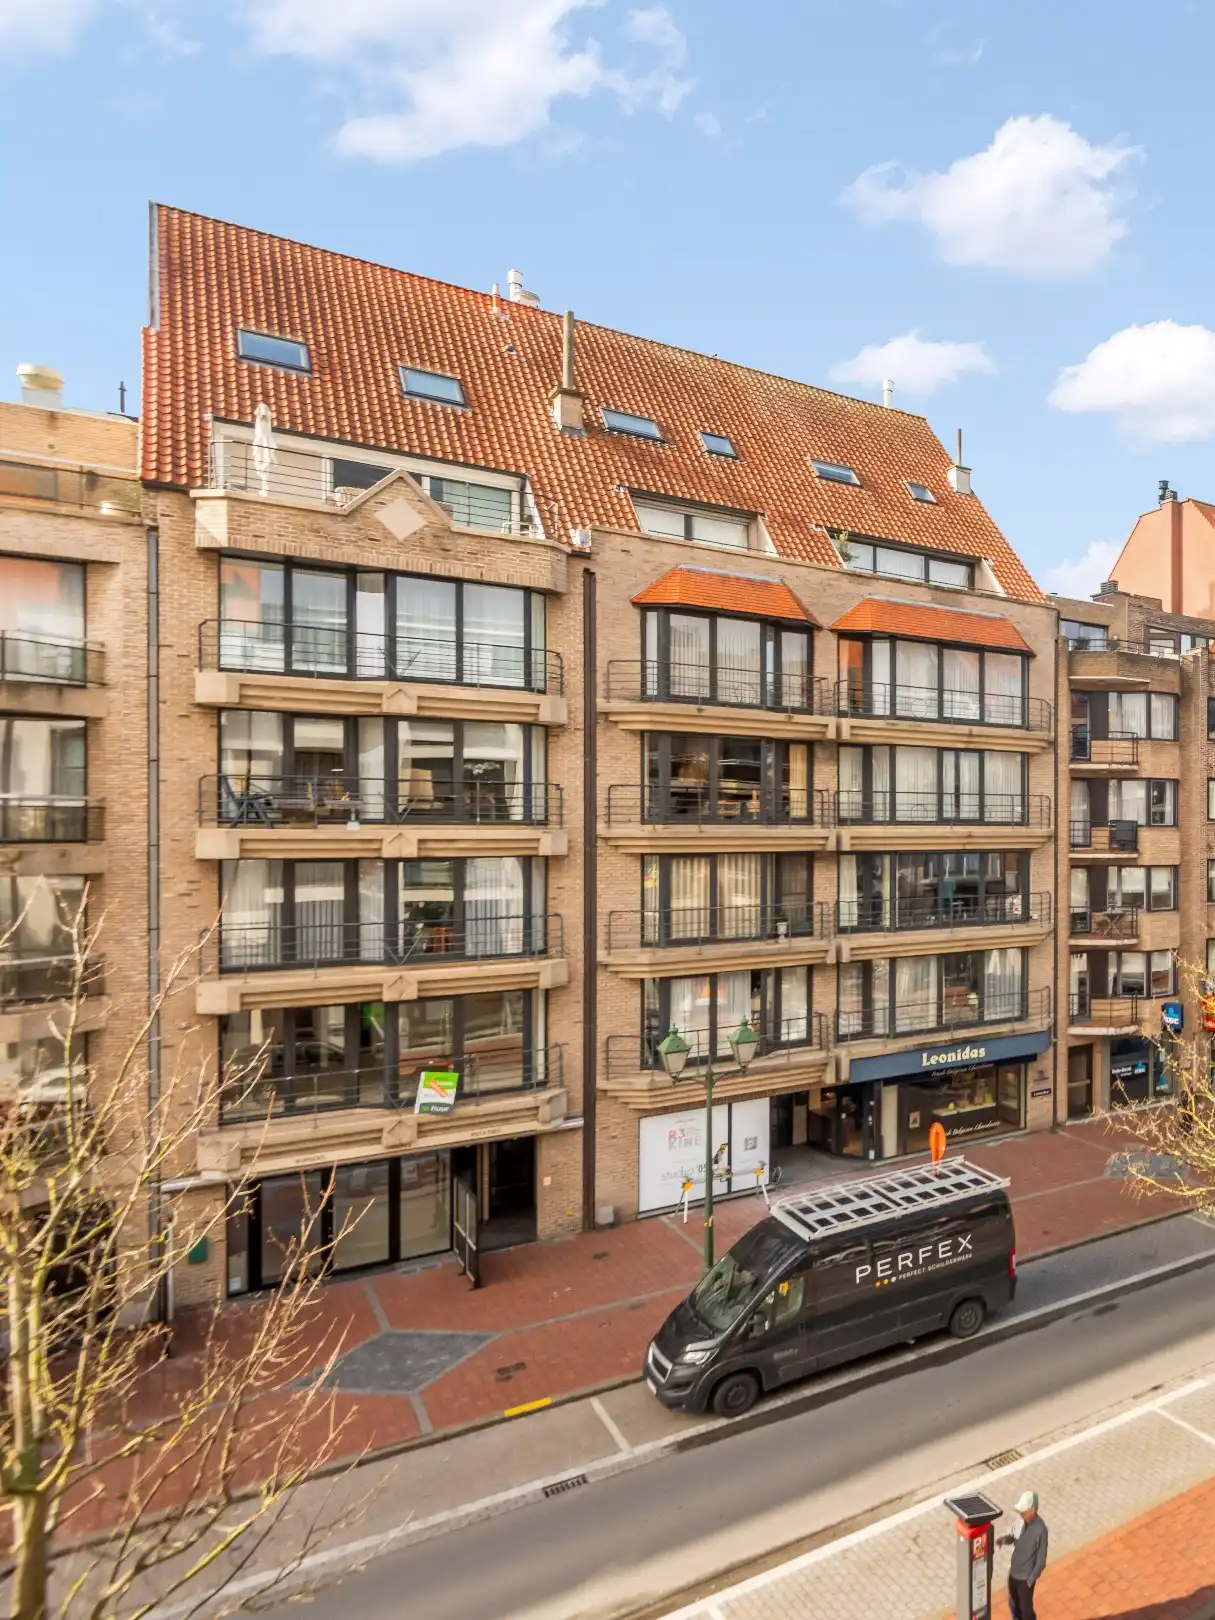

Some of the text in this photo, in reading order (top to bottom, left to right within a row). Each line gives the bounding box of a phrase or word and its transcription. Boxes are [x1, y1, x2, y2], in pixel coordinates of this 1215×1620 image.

[921, 1045, 986, 1067] Leonidas
[855, 1233, 974, 1285] PERFEX
[899, 1266, 927, 1281] PERFECT
